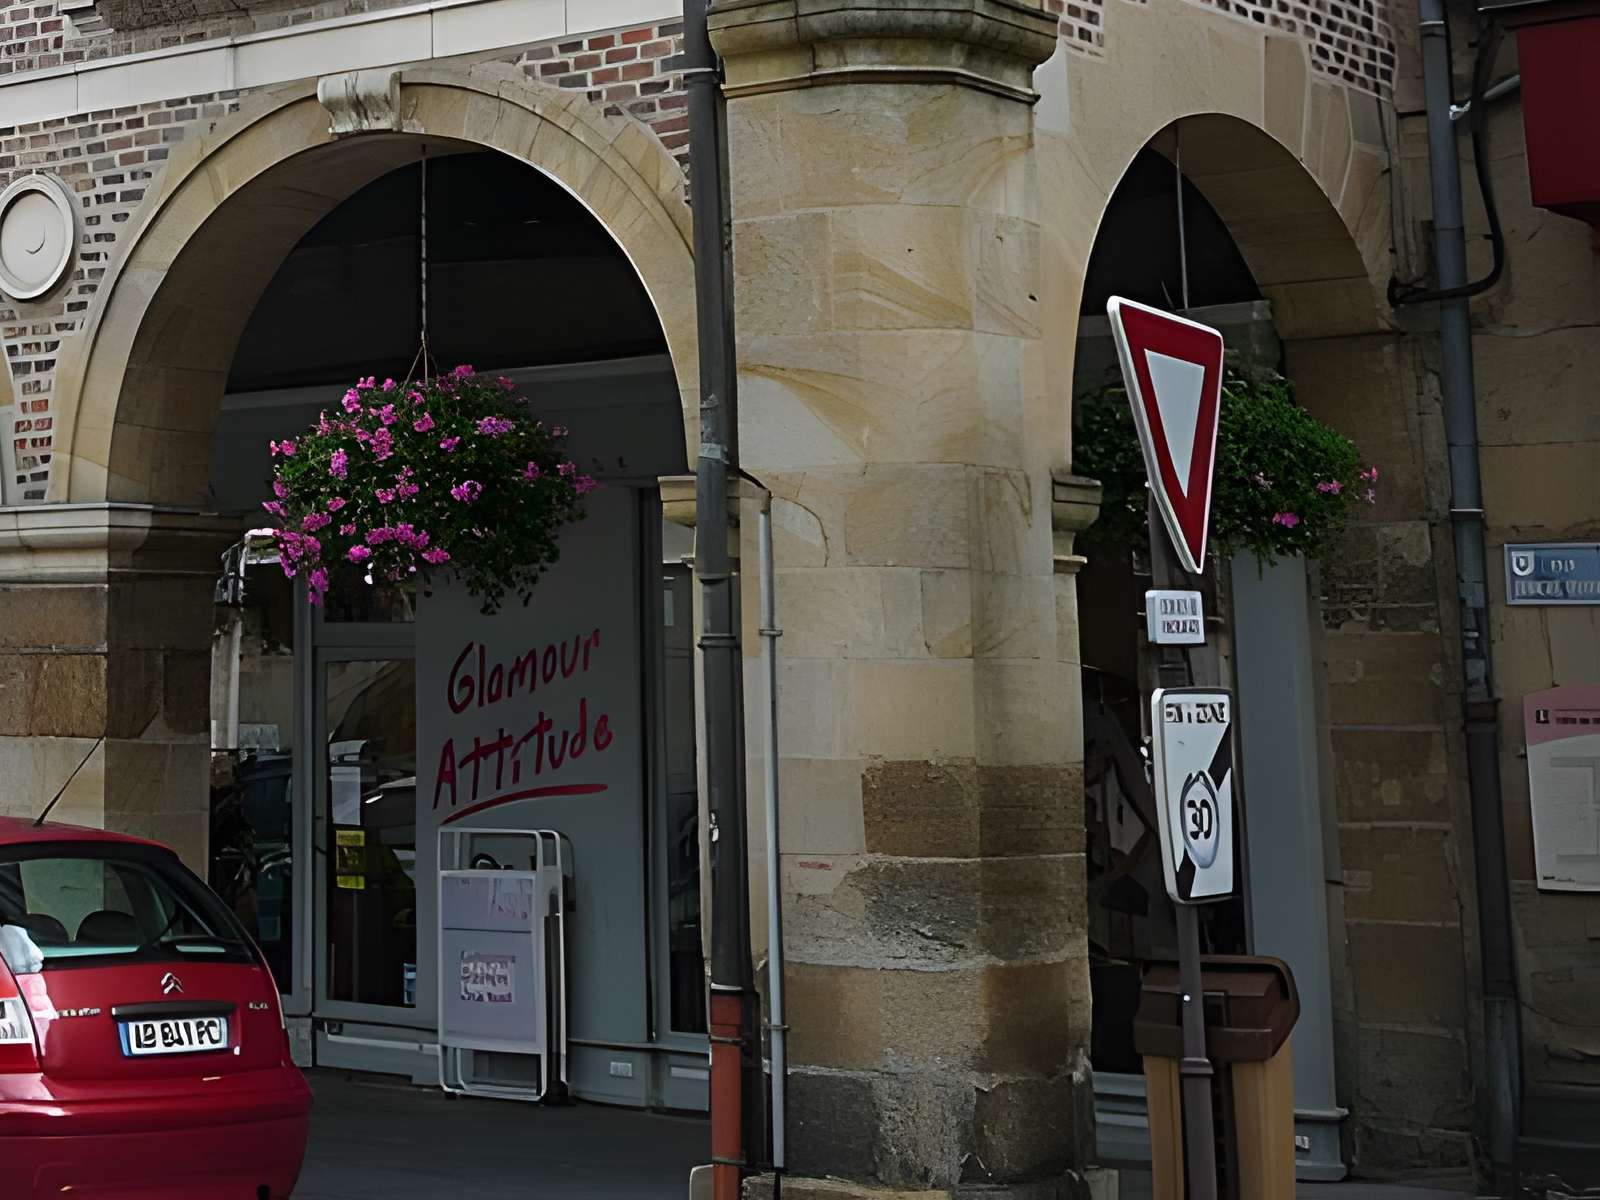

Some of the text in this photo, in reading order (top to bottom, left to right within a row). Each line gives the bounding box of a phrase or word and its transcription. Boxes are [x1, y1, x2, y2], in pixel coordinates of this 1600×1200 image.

[447, 628, 600, 714] Glamour
[432, 697, 614, 811] Attitude
[1187, 798, 1213, 840] 30
